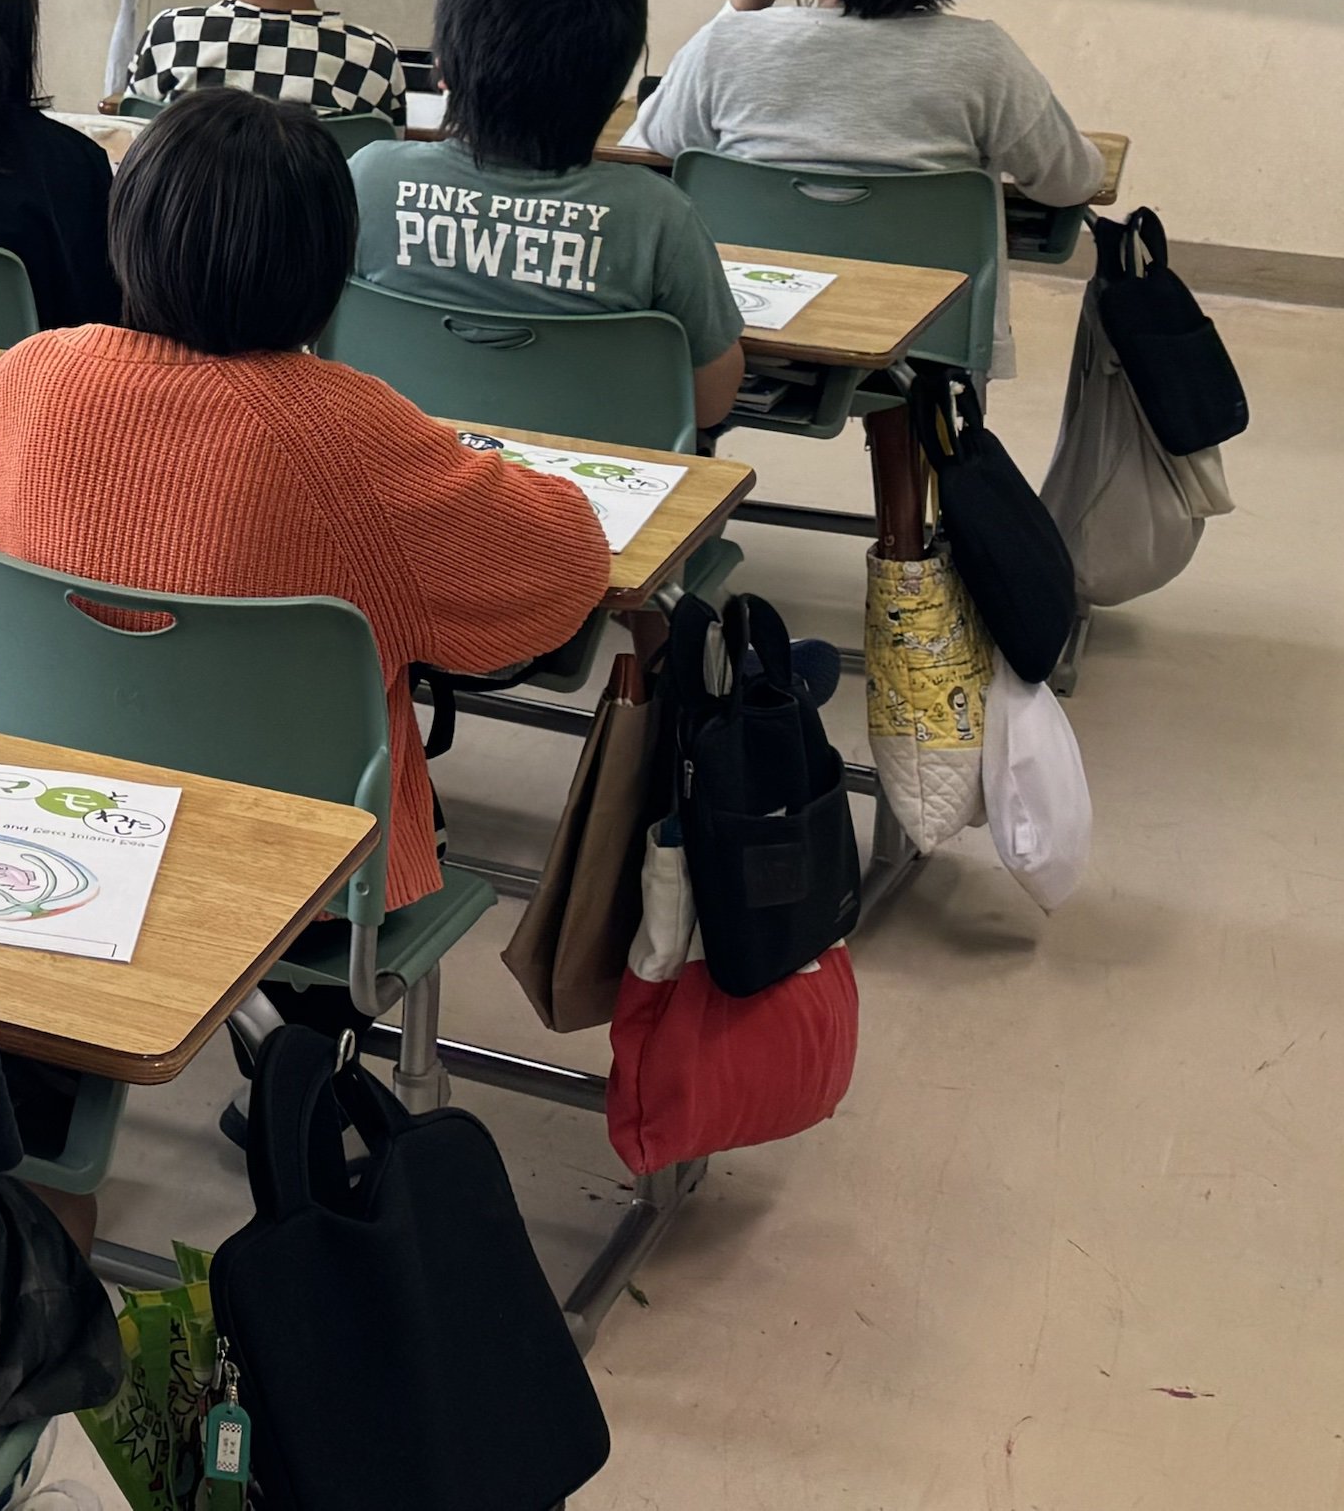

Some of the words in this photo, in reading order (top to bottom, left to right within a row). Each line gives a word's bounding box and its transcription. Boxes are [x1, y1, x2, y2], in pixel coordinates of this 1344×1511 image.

[396, 180, 483, 215] PINK
[488, 195, 610, 231] PUFFY
[396, 211, 603, 292] POWER!
